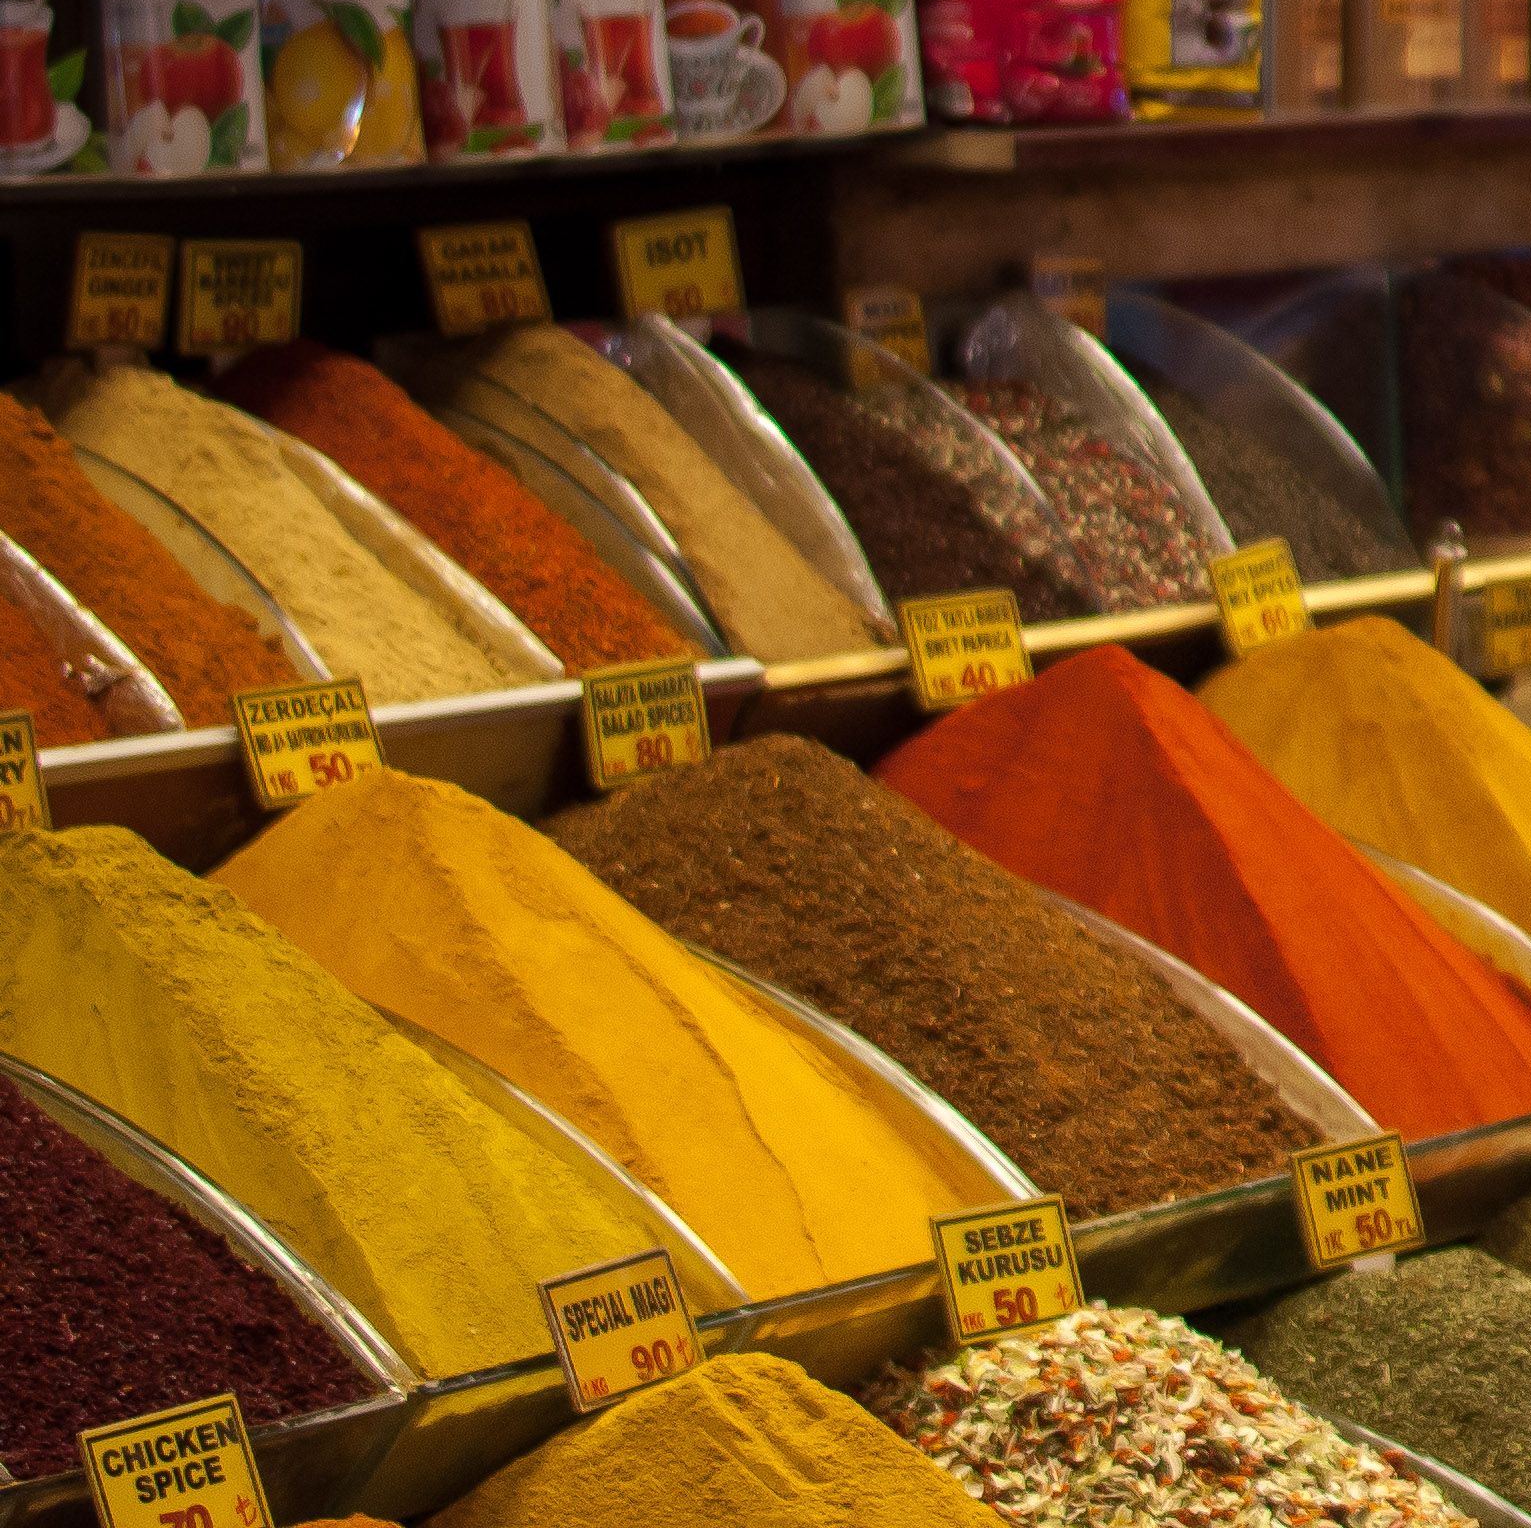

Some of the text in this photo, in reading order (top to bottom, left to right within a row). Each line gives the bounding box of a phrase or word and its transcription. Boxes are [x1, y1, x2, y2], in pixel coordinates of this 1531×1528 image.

[961, 661, 999, 694] 40
[247, 684, 363, 724] ZERDEÇAL
[601, 698, 697, 738] SALAD SPICES
[309, 749, 354, 791] 50
[1311, 1144, 1395, 1186] NANE
[1324, 1176, 1391, 1214] MINT
[964, 1217, 1046, 1255] SEBZE
[1355, 1207, 1393, 1249] 50
[956, 1242, 1065, 1286] KURUSU
[561, 1275, 678, 1343] SPECIAL MAGI
[993, 1285, 1039, 1326] 50
[631, 1338, 676, 1382] 90
[102, 1415, 242, 1479] CHICKEN
[134, 1455, 228, 1505] SPICE
